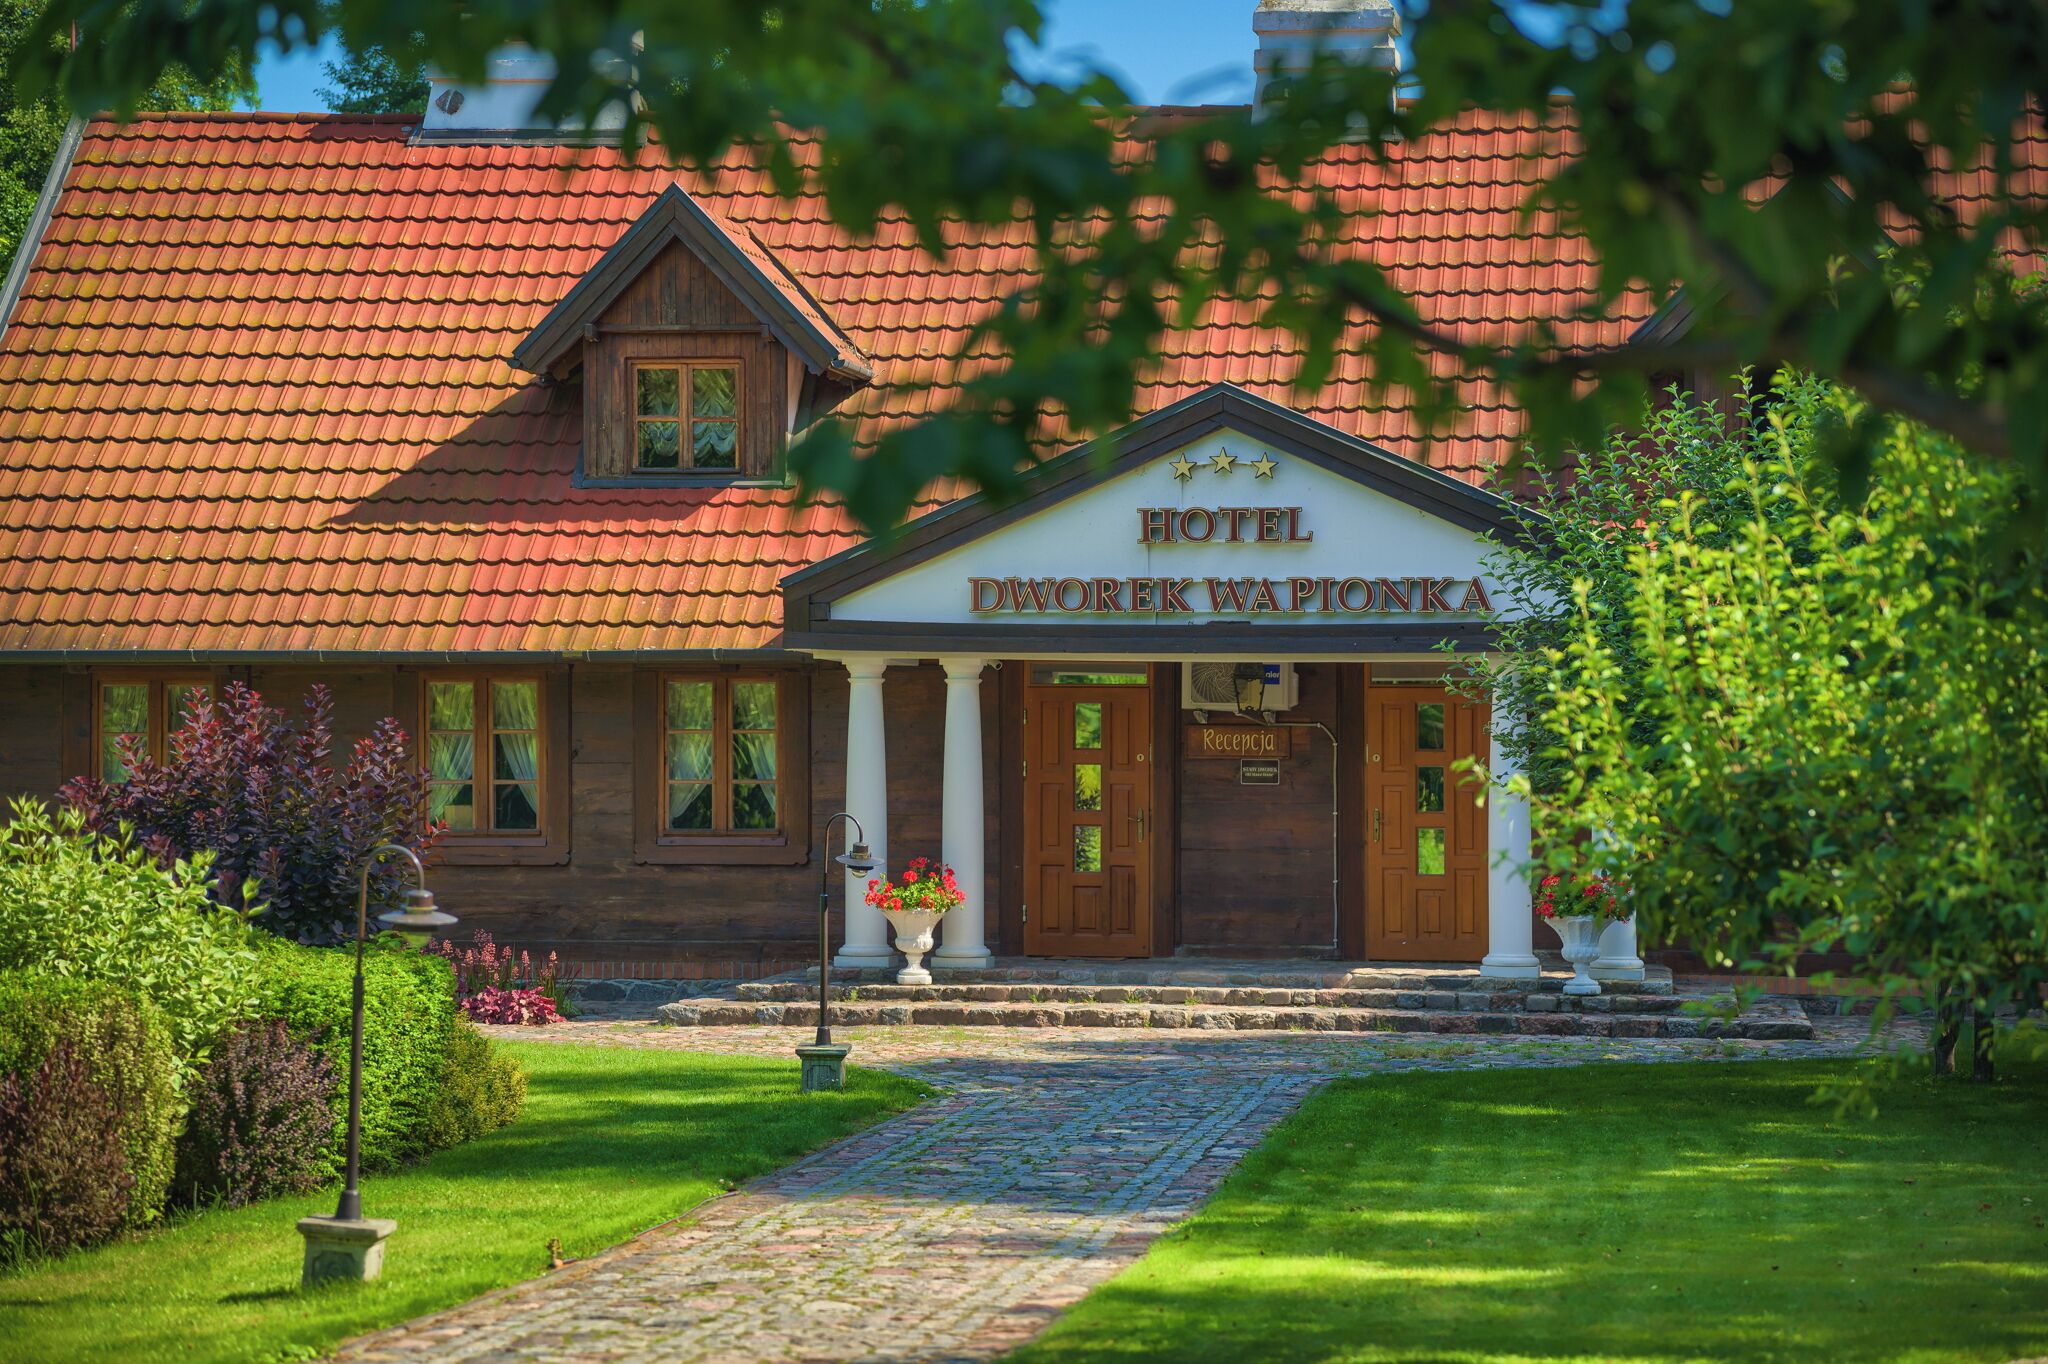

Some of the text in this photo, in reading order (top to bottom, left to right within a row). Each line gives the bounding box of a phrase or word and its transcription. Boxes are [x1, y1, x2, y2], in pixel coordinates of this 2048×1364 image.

[1136, 507, 1313, 544] HOTEL
[968, 576, 1496, 613] DWOREK WAPIONKA
[1203, 728, 1275, 755] Recepcja
